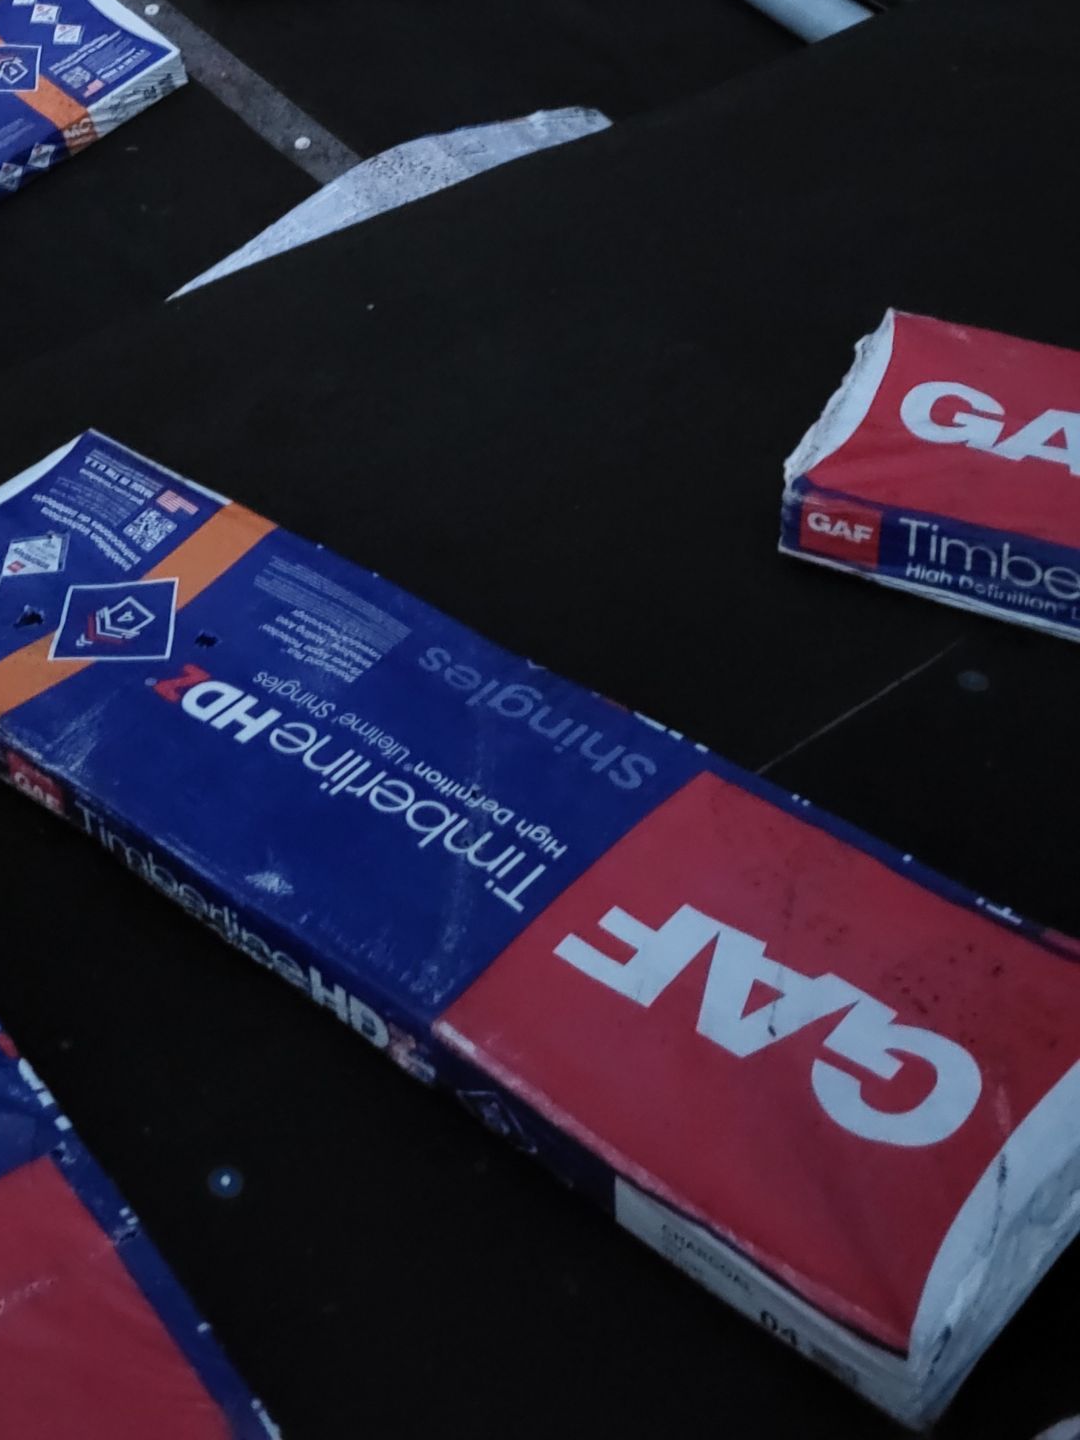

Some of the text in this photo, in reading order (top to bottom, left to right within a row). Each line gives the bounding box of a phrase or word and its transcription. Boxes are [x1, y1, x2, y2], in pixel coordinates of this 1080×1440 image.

[899, 380, 1080, 478] GA
[807, 511, 874, 544] GAF
[905, 560, 954, 588] High
[153, 662, 548, 914] TimberlineHDZ
[252, 670, 569, 861] High Definition Lifetime Shingles
[418, 646, 658, 792] Shingles
[551, 902, 984, 1148] GAF
